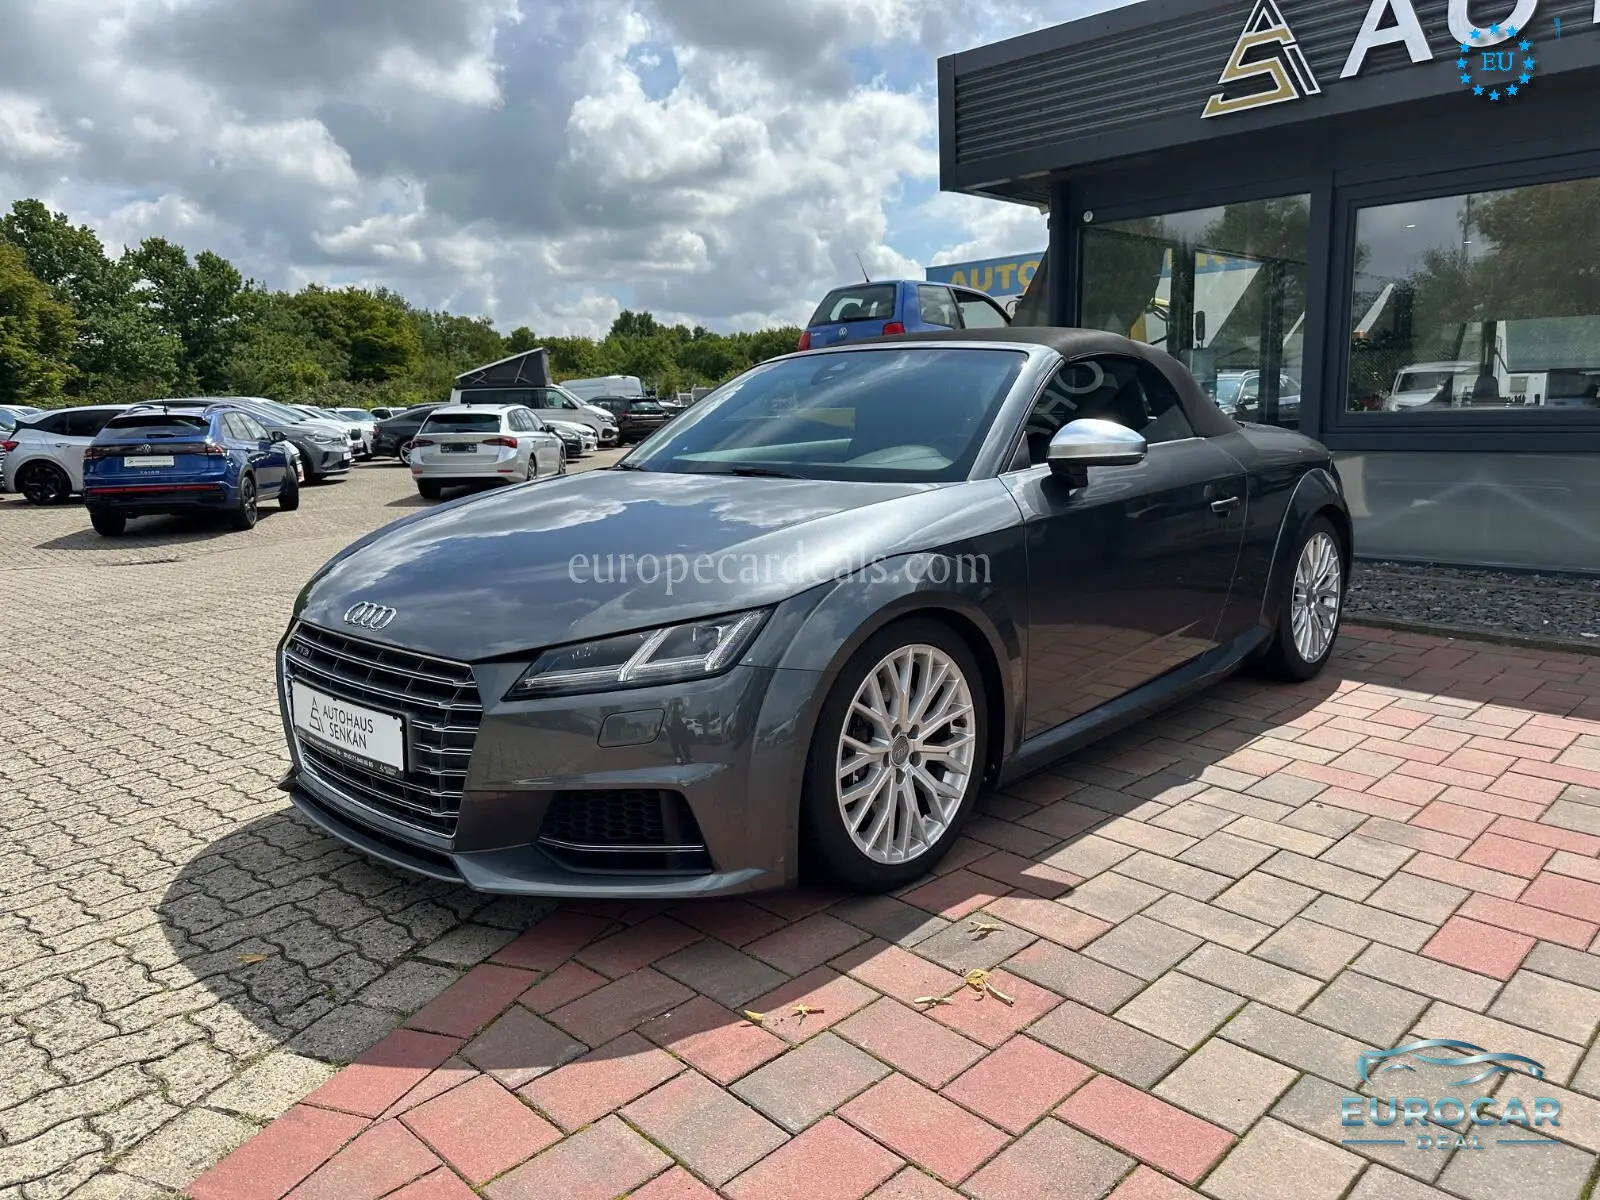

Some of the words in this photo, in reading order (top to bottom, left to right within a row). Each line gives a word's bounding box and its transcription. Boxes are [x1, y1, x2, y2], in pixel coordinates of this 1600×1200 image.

[950, 260, 1041, 293] AUTO
[322, 704, 374, 734] AUTOHAUS
[329, 721, 367, 750] SENKAN
